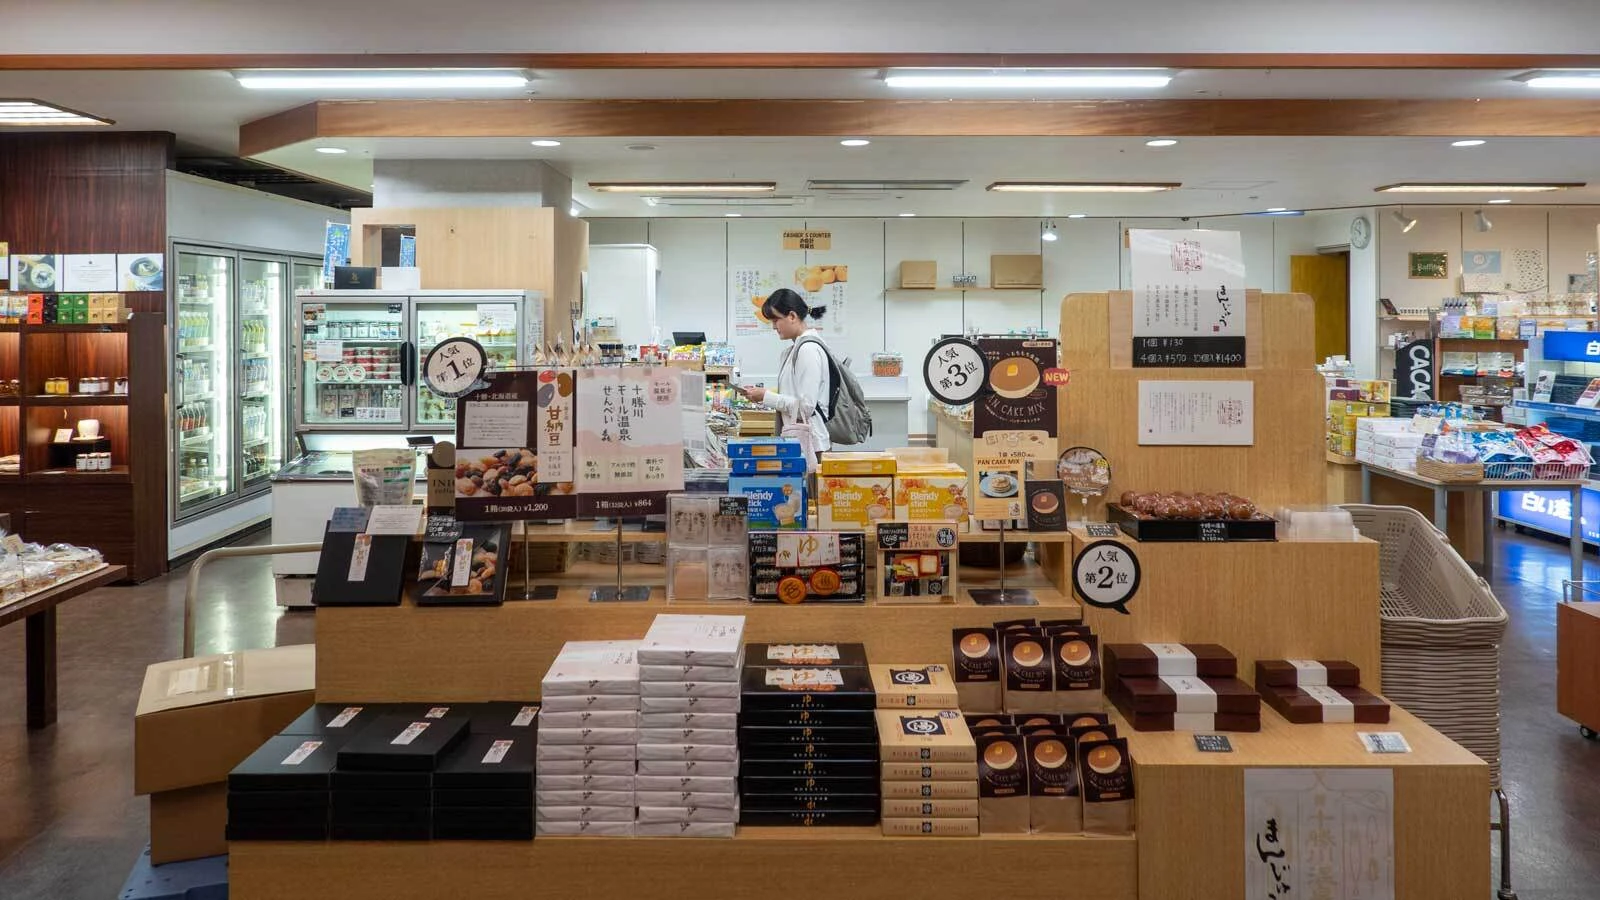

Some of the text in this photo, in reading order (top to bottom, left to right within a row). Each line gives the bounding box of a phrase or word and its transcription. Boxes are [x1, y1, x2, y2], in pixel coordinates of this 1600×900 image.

[439, 344, 460, 361] 人気
[938, 347, 959, 368] 人気
[436, 358, 475, 384] 第1位
[939, 360, 978, 391] 第3位
[1046, 372, 1068, 382] NEW
[1409, 345, 1432, 400] CACA
[603, 386, 614, 424] せんべい
[632, 384, 646, 418] 十勝川
[1001, 404, 1024, 416] CAKE
[1028, 402, 1045, 416] MIX
[618, 385, 632, 440] モール温泉
[545, 405, 563, 446] 甘納豆
[834, 491, 862, 502] Blendy
[910, 491, 938, 502] Blendy
[799, 535, 818, 556] ゆ
[1095, 552, 1118, 562] 人気
[1085, 566, 1128, 588] 第2位
[1256, 818, 1290, 900] まんじゅ
